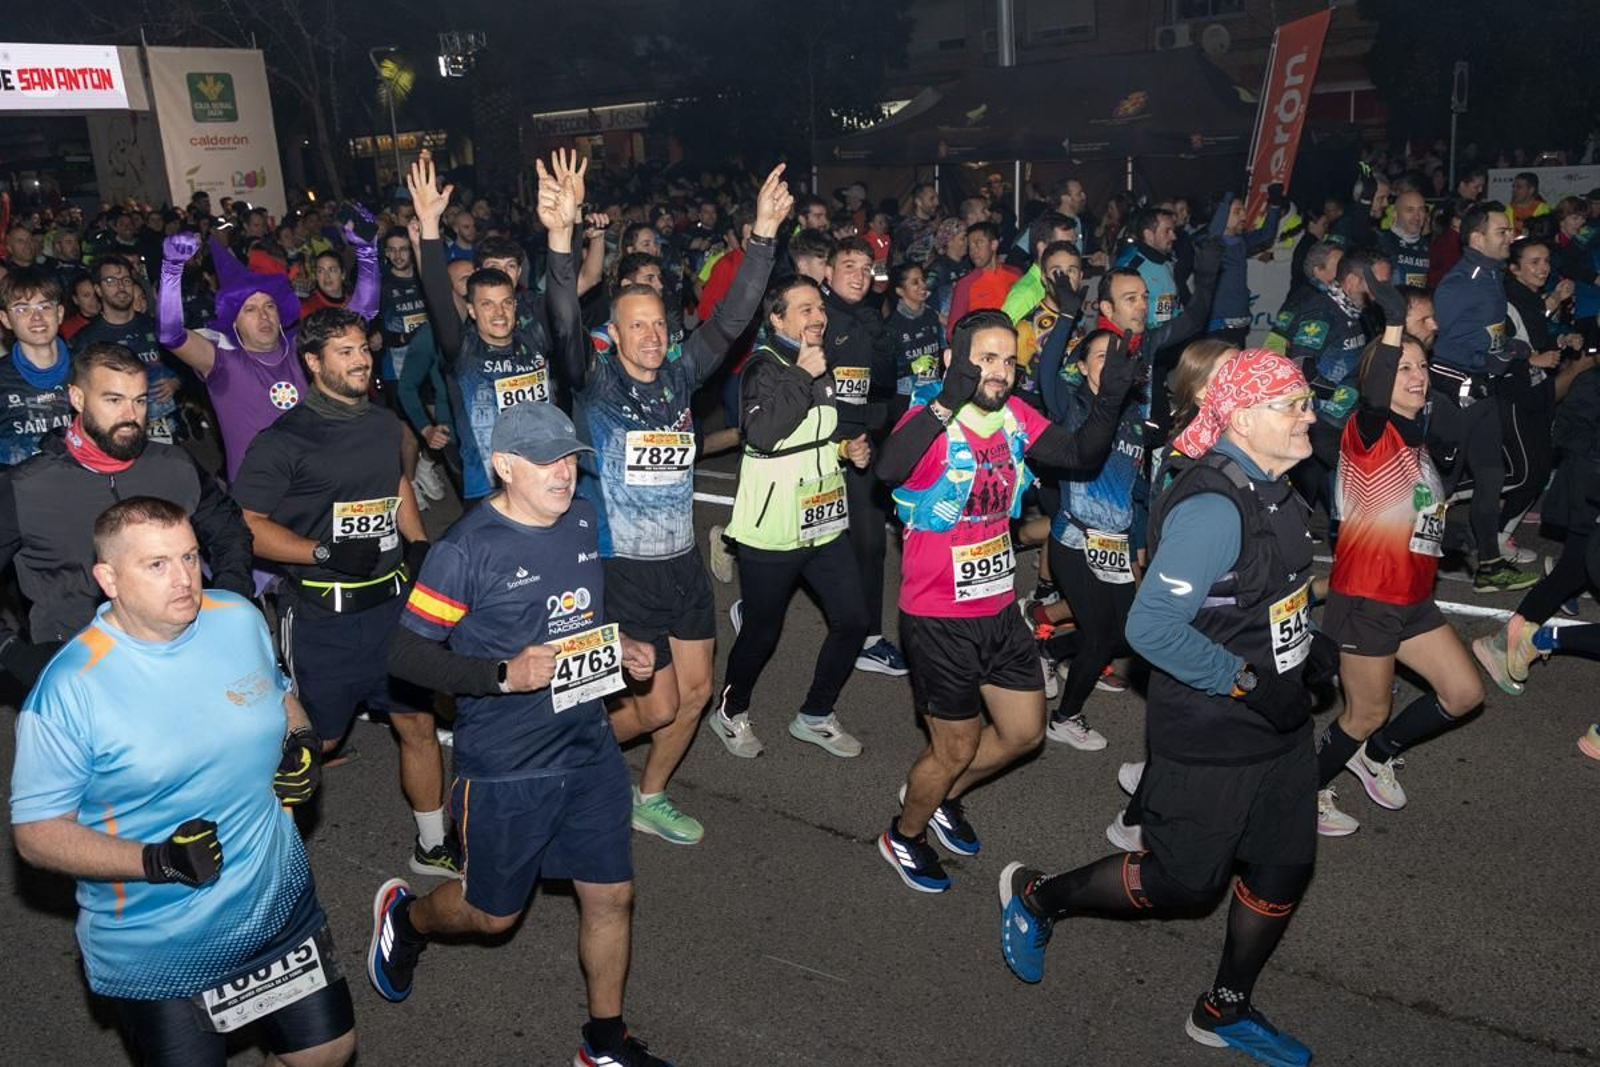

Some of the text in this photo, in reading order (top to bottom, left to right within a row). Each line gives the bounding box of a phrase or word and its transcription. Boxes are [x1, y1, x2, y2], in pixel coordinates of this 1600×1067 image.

[0, 69, 15, 91] E
[16, 68, 55, 91] SAN
[502, 383, 546, 406] 8013
[836, 379, 868, 393] 7949
[13, 418, 48, 435] SAN
[633, 447, 690, 465] 7827
[804, 498, 845, 524] 8878
[340, 511, 394, 535] 5824
[960, 549, 1011, 580] 9957
[1087, 548, 1127, 568] 9906
[548, 618, 594, 635] NACIONAL
[556, 644, 617, 682] 4763
